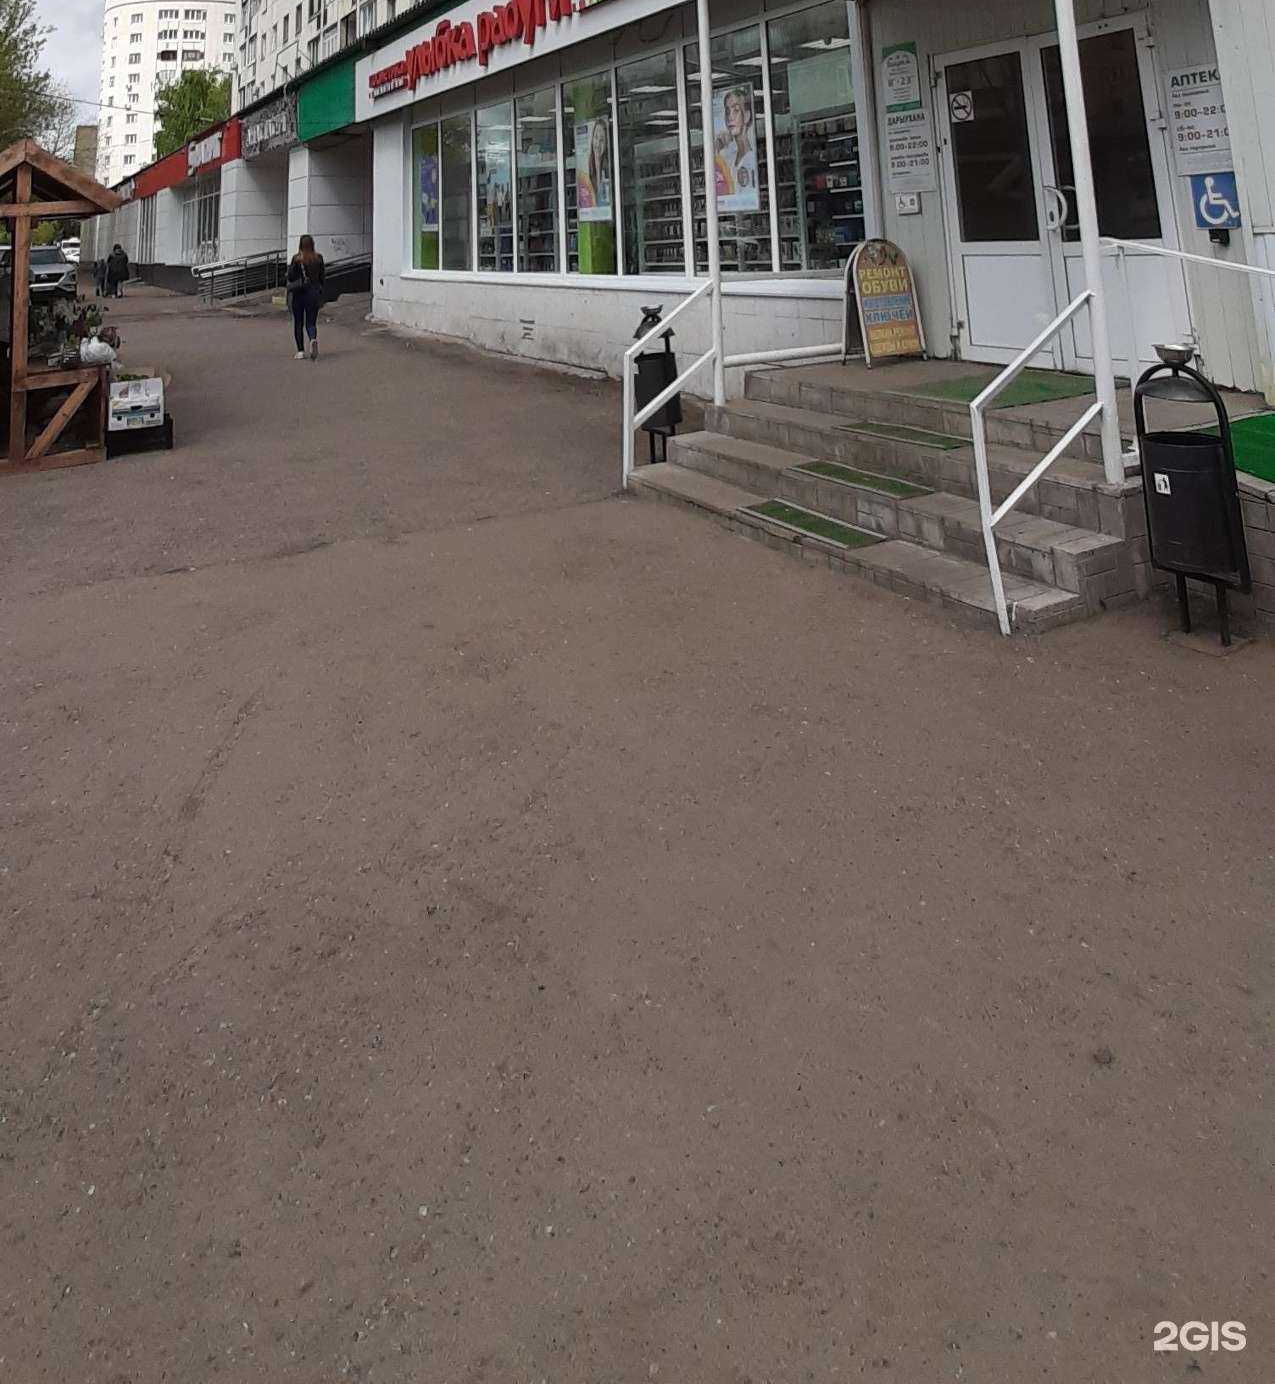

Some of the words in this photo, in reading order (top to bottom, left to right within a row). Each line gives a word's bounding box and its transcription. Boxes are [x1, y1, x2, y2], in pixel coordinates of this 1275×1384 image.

[405, 20, 477, 91] улыбка
[1171, 69, 1220, 87] АПТЕК
[1174, 104, 1226, 119] 9:00-22:0
[1178, 128, 1230, 142] 9:00-21:0
[859, 266, 907, 280] РЕМОНТ
[862, 278, 908, 294] ОБУВИ
